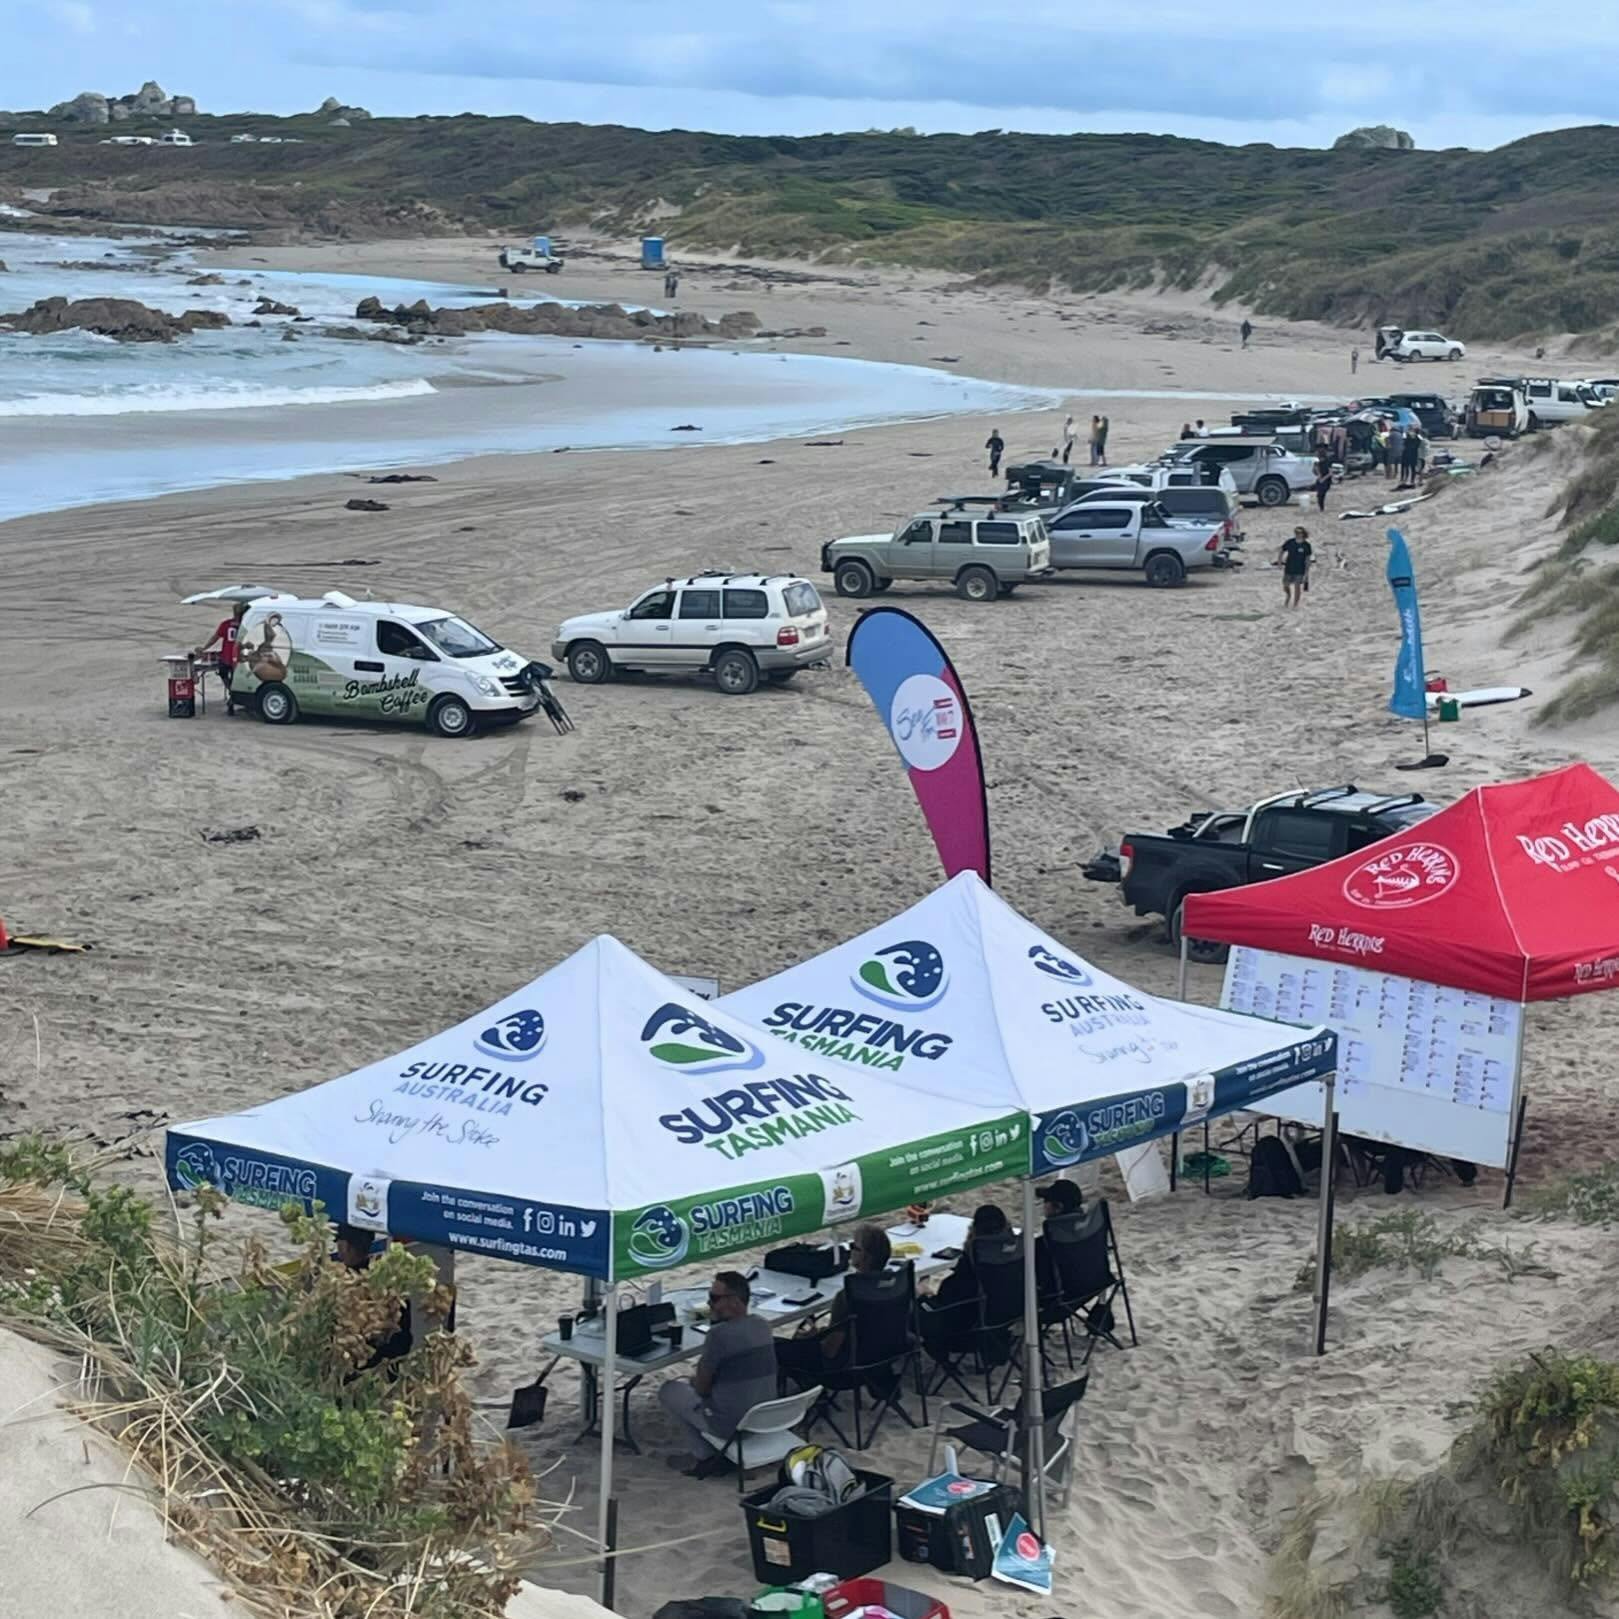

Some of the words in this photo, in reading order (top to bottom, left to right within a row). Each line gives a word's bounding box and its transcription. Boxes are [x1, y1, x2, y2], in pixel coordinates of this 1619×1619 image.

[343, 668, 421, 700] Bombshell
[380, 690, 429, 715] Coffee
[1040, 993, 1145, 1023] SURFING
[761, 1002, 954, 1061] SURFING
[393, 1081, 514, 1117] AUSTRALIA
[399, 1061, 550, 1107] SURFING
[658, 1073, 855, 1145] SURFING
[1088, 1091, 1165, 1137] SURFING
[704, 1102, 864, 1161] TASMANIA
[223, 1157, 318, 1201] SURFING
[421, 1191, 440, 1203] Join
[441, 1194, 456, 1207] the
[457, 1198, 514, 1216] conversation
[443, 1210, 455, 1220] on
[456, 1212, 482, 1224] social
[689, 1186, 795, 1235] SURFING
[448, 1231, 568, 1262] www.surfingtas.com
[699, 1217, 783, 1254] TASMANIA
